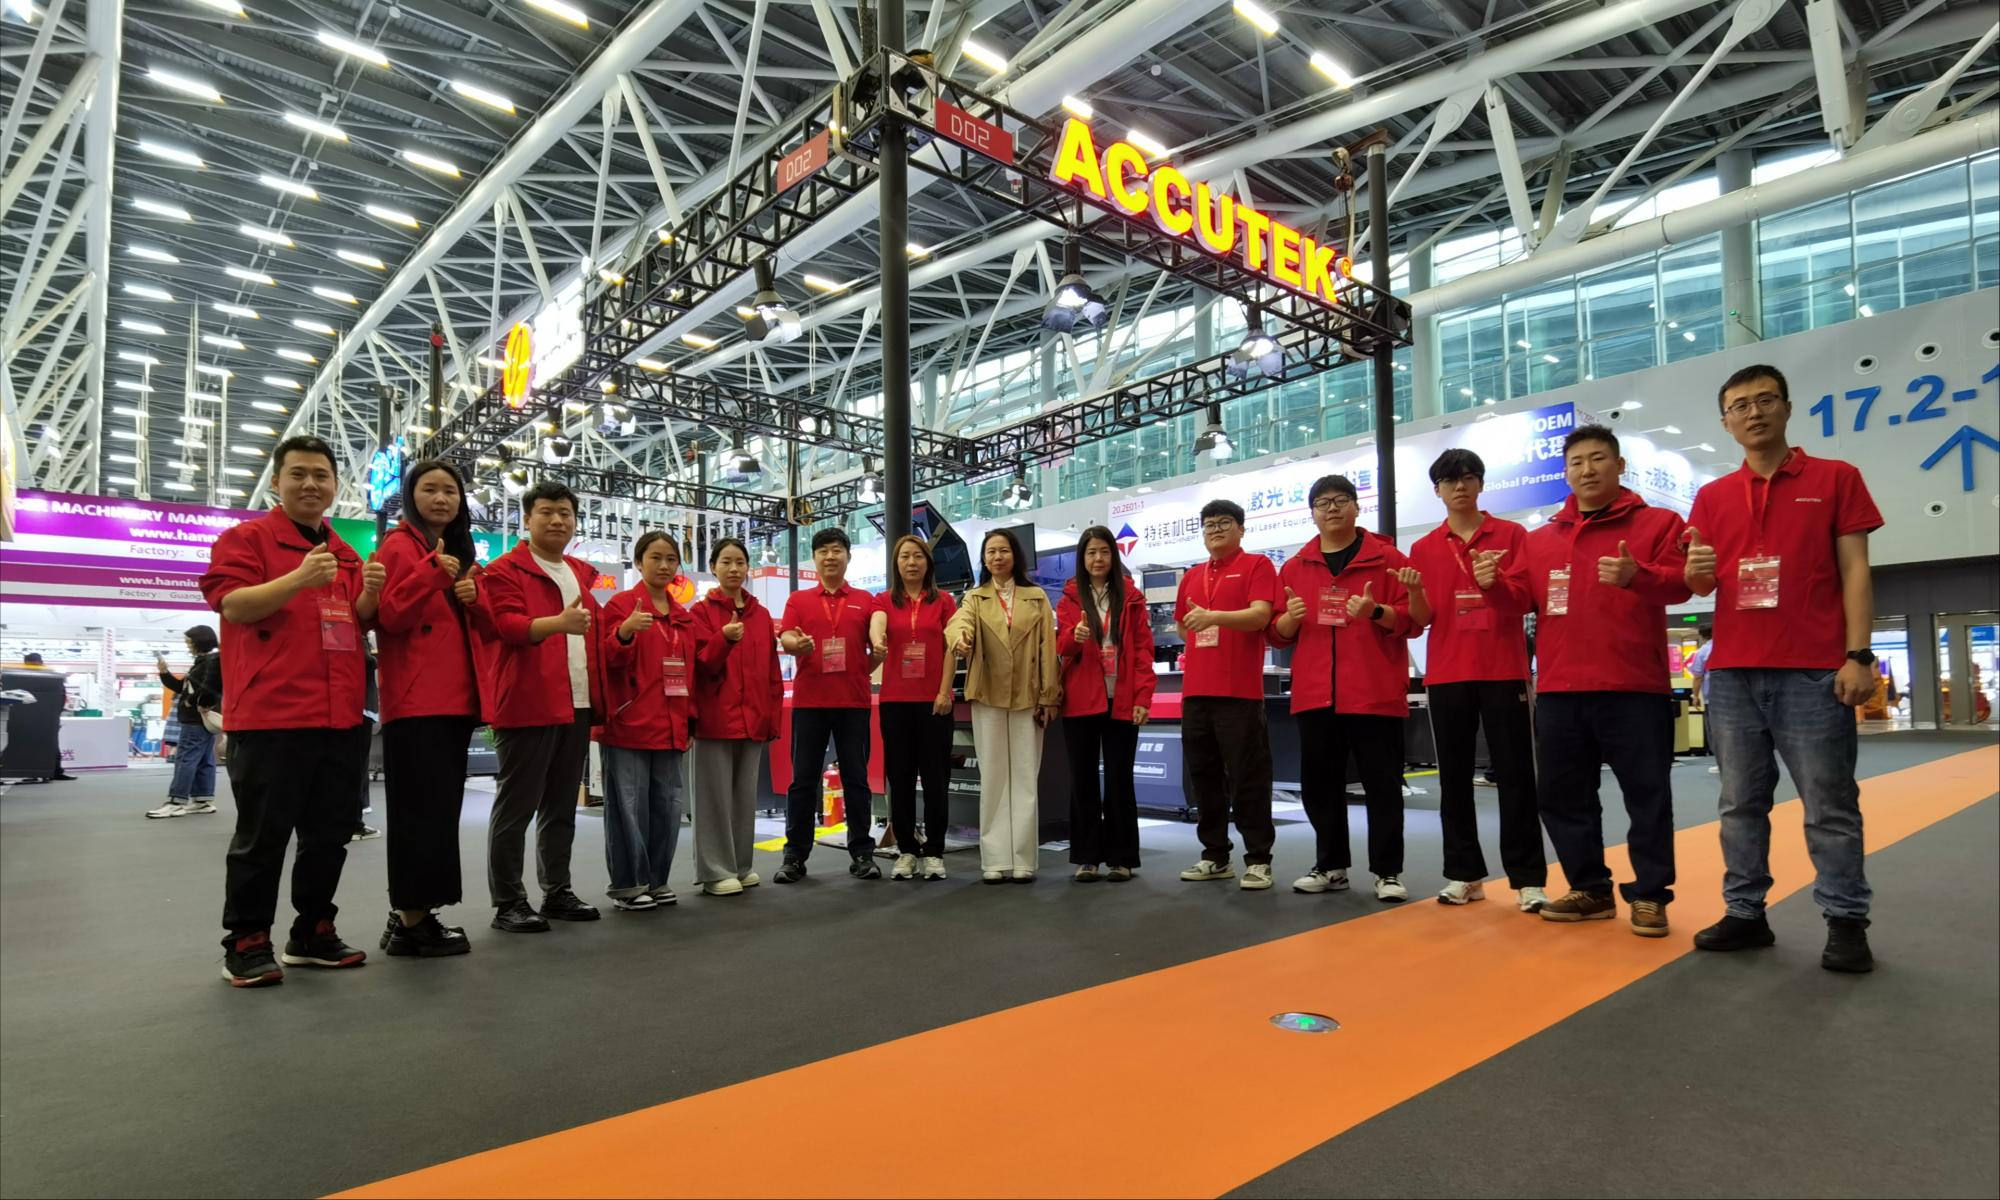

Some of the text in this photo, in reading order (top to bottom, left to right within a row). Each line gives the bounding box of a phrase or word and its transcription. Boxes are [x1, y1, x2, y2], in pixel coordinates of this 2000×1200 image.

[951, 114, 990, 150] D02
[786, 149, 812, 183] D02
[1050, 117, 1338, 304] ACCUTEK
[1485, 477, 1519, 491] Global
[51, 501, 163, 522] MACHINERY
[168, 512, 249, 528] MANUFA
[1259, 521, 1281, 532] Laser
[119, 575, 199, 588] www.hanniu
[169, 591, 204, 601] Guang
